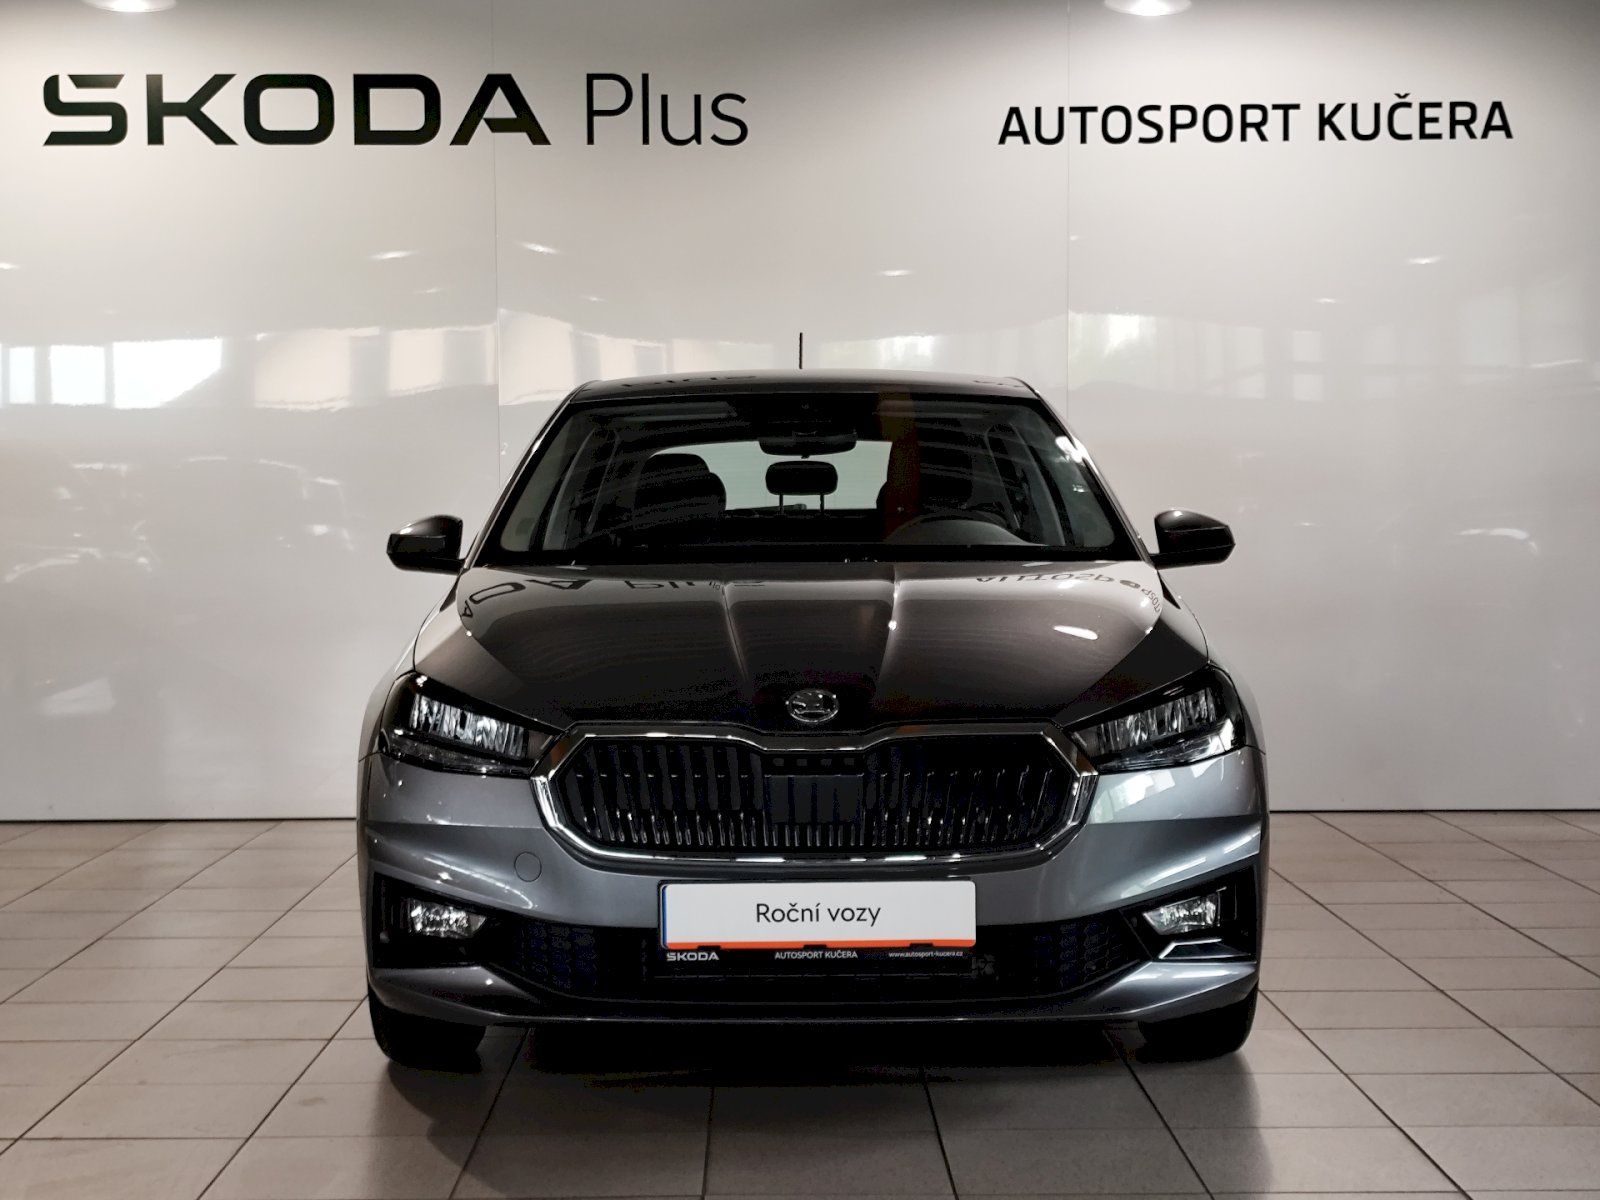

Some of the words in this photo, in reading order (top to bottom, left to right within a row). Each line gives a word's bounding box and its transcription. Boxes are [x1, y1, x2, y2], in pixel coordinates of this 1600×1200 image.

[585, 72, 749, 147] Plus
[998, 103, 1301, 146] AUTOSPORT
[1318, 92, 1514, 142] KUČERA
[756, 902, 821, 923] Roční
[827, 907, 881, 927] vozy
[774, 951, 823, 960] AUTOSPORT
[825, 949, 859, 959] KUČERA
